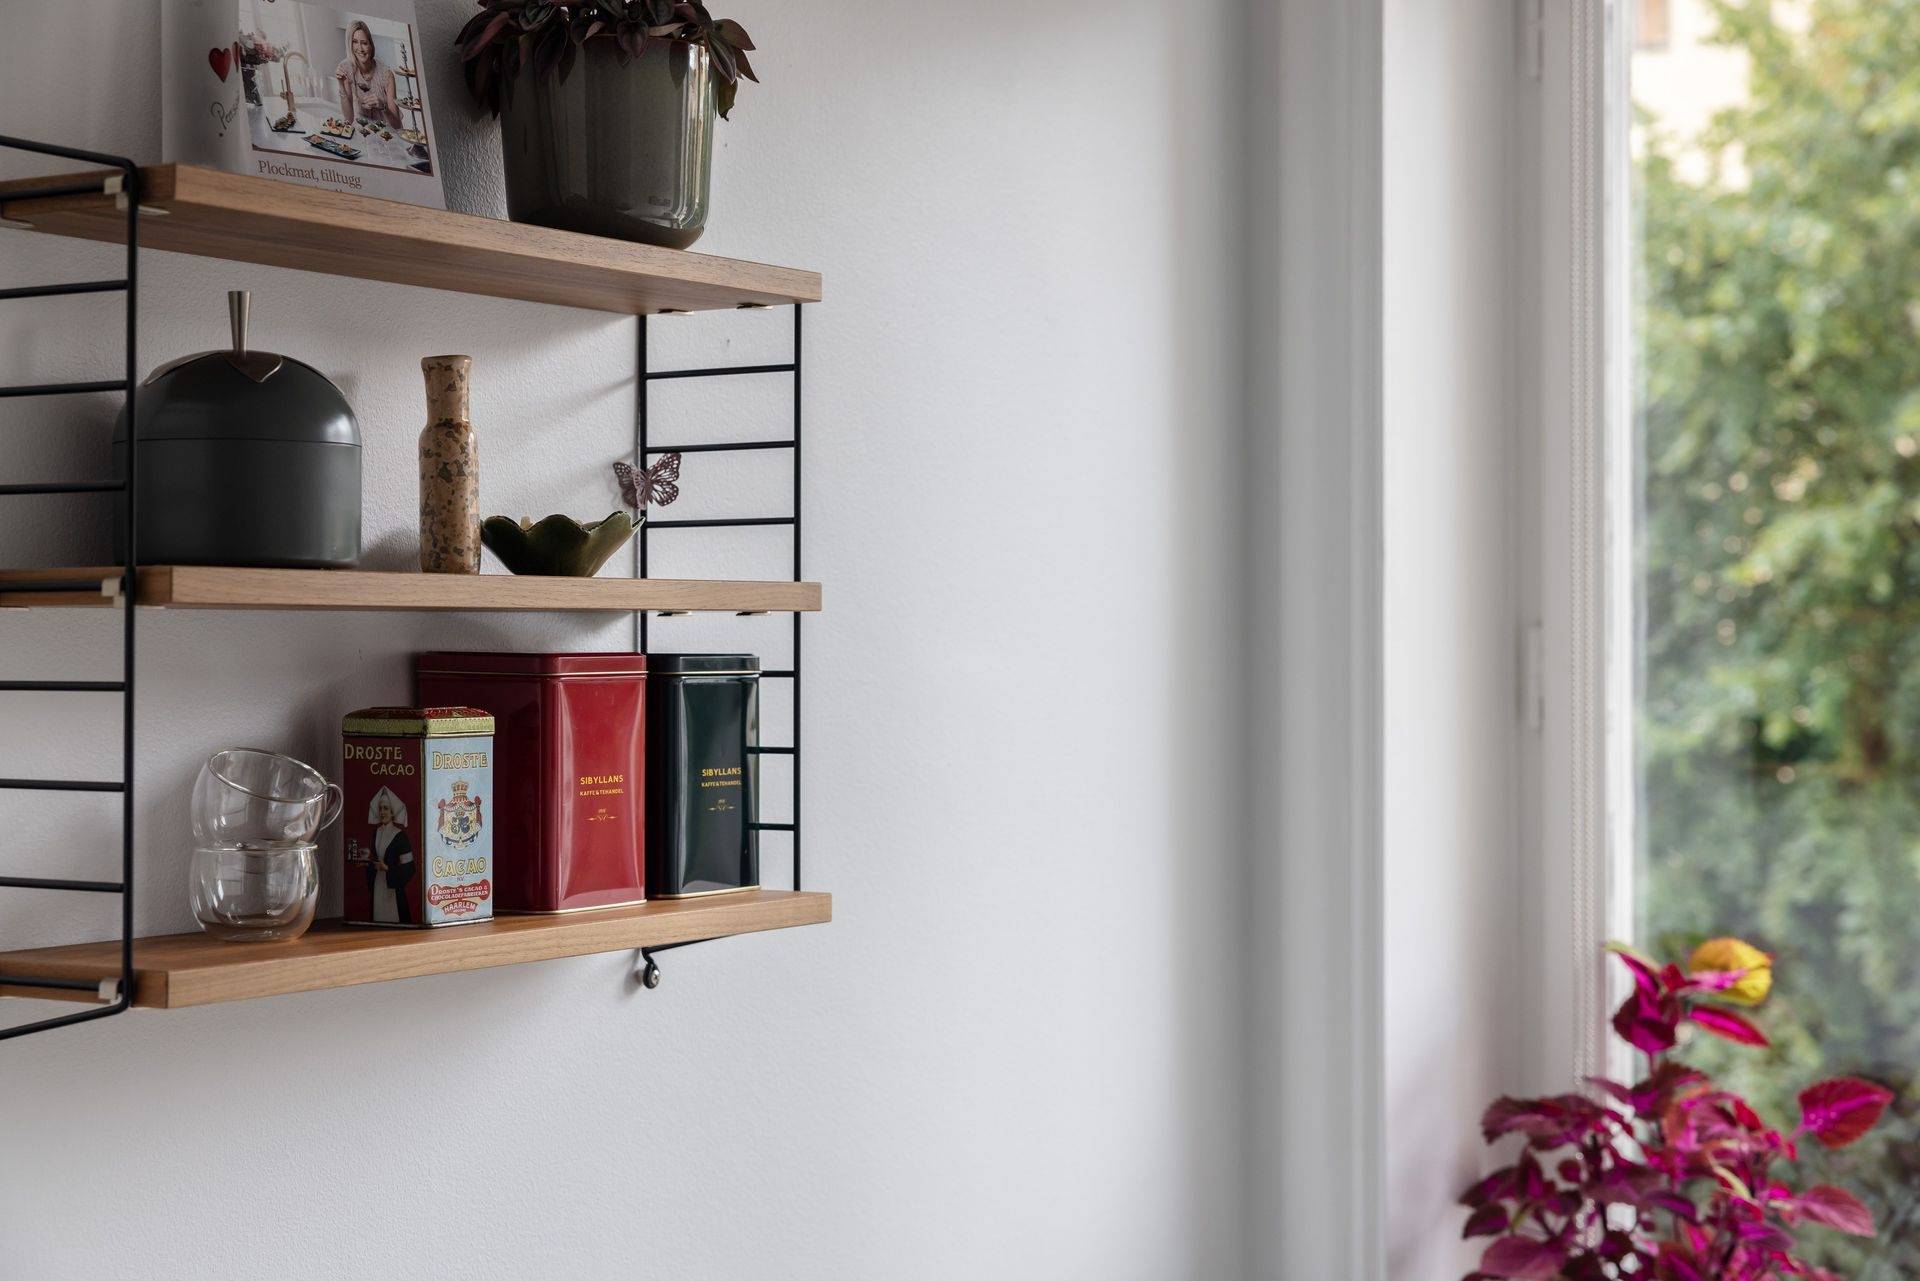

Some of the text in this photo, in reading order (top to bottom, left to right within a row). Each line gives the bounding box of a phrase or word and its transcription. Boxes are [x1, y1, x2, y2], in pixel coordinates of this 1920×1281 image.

[257, 160, 362, 189] Plockmat, tilltugg
[344, 743, 403, 760] DROSTE
[432, 751, 488, 770] DROSTE
[370, 762, 415, 777] CACAO
[701, 767, 742, 777] SIBYLLANS
[580, 774, 624, 785] SIBYLLANS
[432, 855, 487, 877] CACAO
[444, 901, 477, 913] HAARLEM
